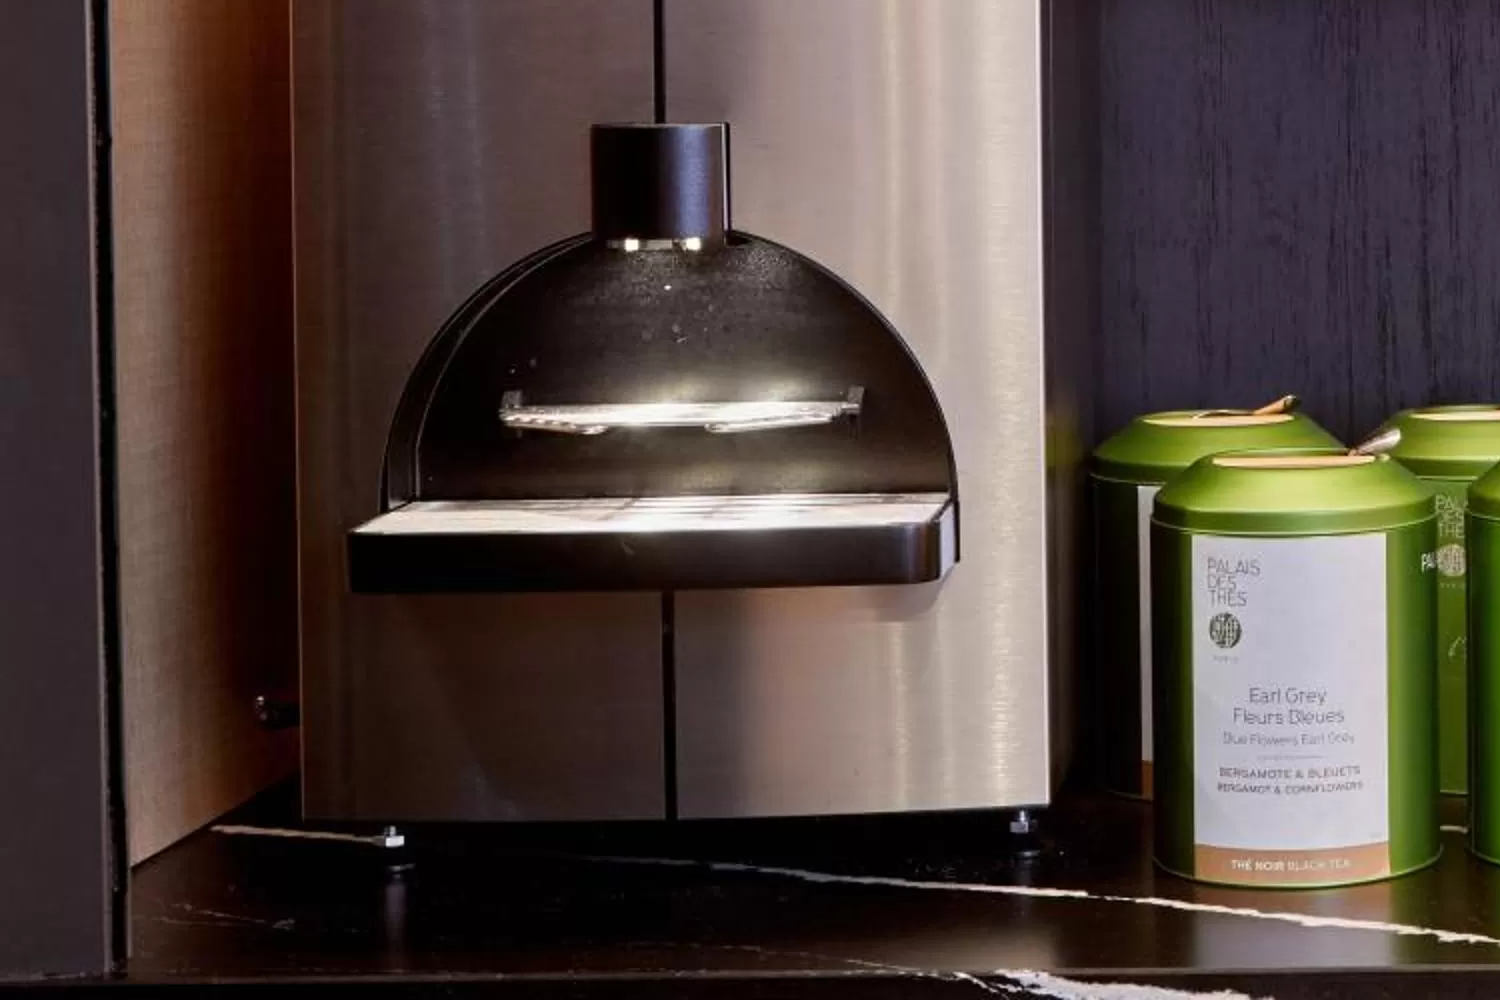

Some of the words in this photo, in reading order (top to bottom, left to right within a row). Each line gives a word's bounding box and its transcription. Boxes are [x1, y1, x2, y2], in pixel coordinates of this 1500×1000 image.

[1207, 556, 1261, 576] PALAIS
[1207, 574, 1237, 590] DES
[1249, 687, 1281, 704] Earl
[1285, 687, 1327, 706] Grey
[1233, 707, 1284, 725] Fleurs
[1289, 708, 1345, 726] Bleues
